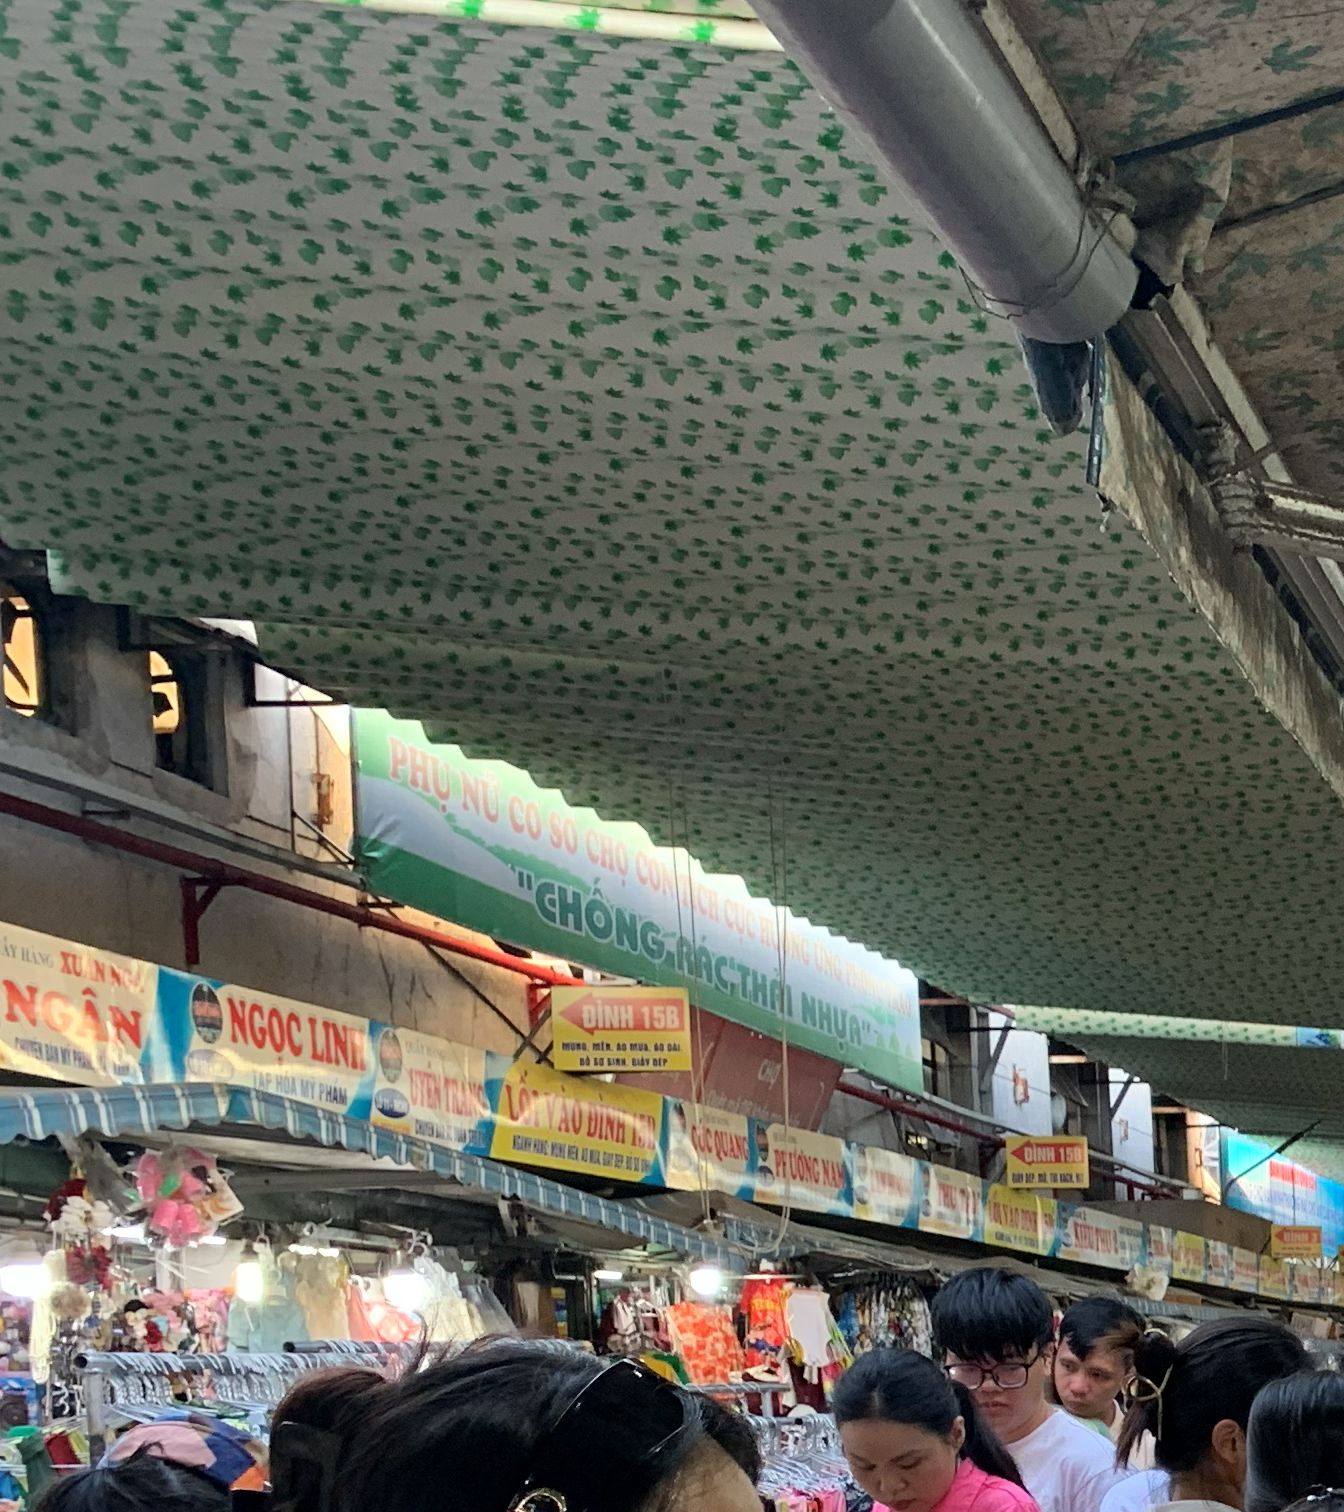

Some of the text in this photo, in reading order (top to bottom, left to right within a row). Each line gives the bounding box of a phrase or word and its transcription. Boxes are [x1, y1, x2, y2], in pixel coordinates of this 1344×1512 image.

[388, 736, 450, 813] PHỤ
[2, 978, 142, 1049] NGÂN
[226, 996, 367, 1072] NGỌC LINH
[582, 1003, 680, 1030] ĐÌNH 15B
[545, 1083, 582, 1135] VÀO
[1024, 1143, 1082, 1163] ĐÌNH 15B
